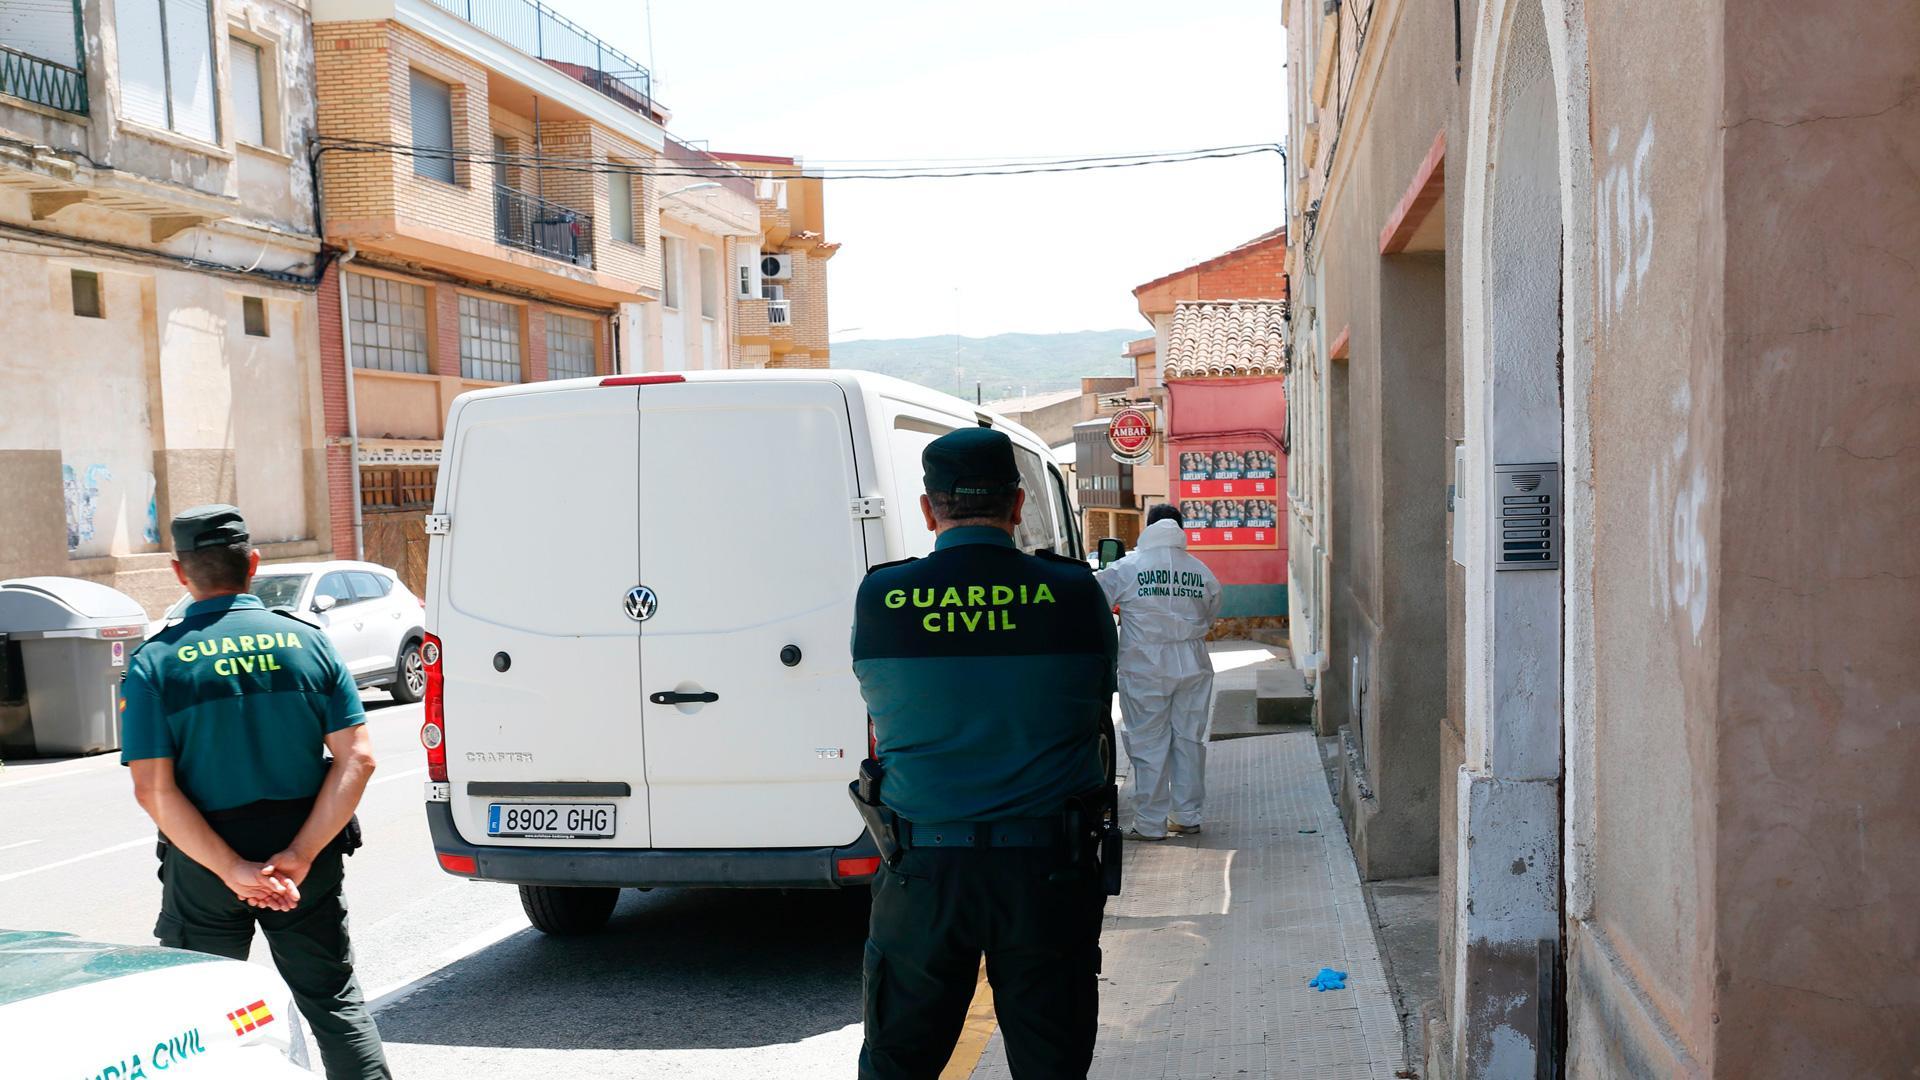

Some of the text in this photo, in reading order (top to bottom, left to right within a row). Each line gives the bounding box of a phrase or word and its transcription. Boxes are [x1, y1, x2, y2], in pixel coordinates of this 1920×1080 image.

[1113, 427, 1147, 437] AMBAR
[1181, 572, 1205, 587] CIVIL
[884, 583, 1056, 609] GUARDIA
[922, 610, 1017, 632] CIVIL
[177, 632, 303, 662] GUARDIA
[214, 653, 282, 676] CIVIL
[465, 752, 534, 762] CRAFTER
[815, 747, 844, 759] TDI
[506, 809, 558, 831] 8902
[567, 809, 607, 831] GHG
[152, 1027, 206, 1070] CIVIL
